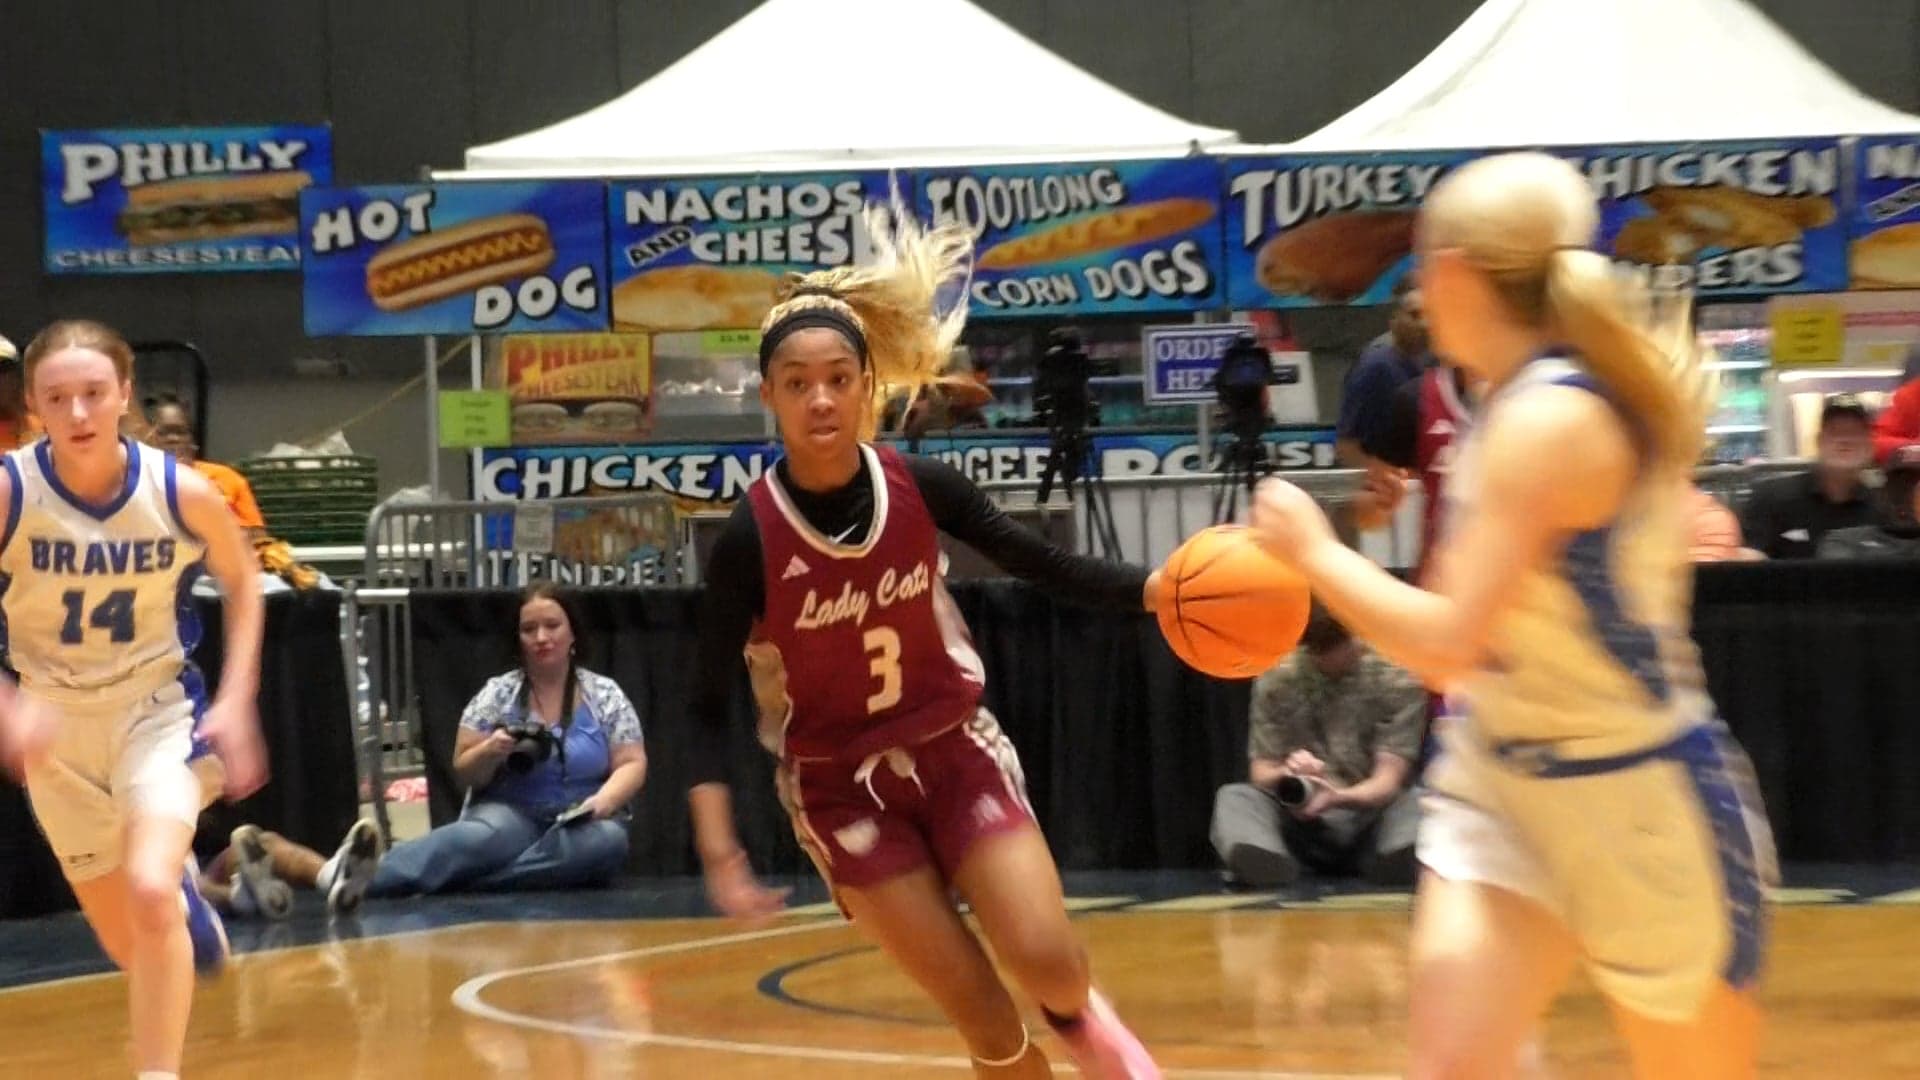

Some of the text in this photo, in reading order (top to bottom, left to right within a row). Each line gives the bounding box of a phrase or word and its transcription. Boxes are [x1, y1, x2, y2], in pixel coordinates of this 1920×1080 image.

[61, 141, 307, 204] PHILLY
[1588, 148, 1836, 200] HICKEN
[312, 192, 432, 252] HOT
[625, 181, 865, 225] NACHOS
[927, 168, 1124, 241] FOOTLONG
[1231, 164, 1441, 248] TURKEY
[630, 226, 693, 265] AND
[971, 240, 1209, 307] CORN DOGS
[473, 266, 596, 327] DOG
[1157, 337, 1233, 361] ORDE
[483, 454, 763, 501] CHICKEN
[29, 537, 176, 574] BRAVES
[60, 588, 137, 643] 14
[794, 560, 929, 628] Lady Cats
[863, 626, 902, 714] 3
